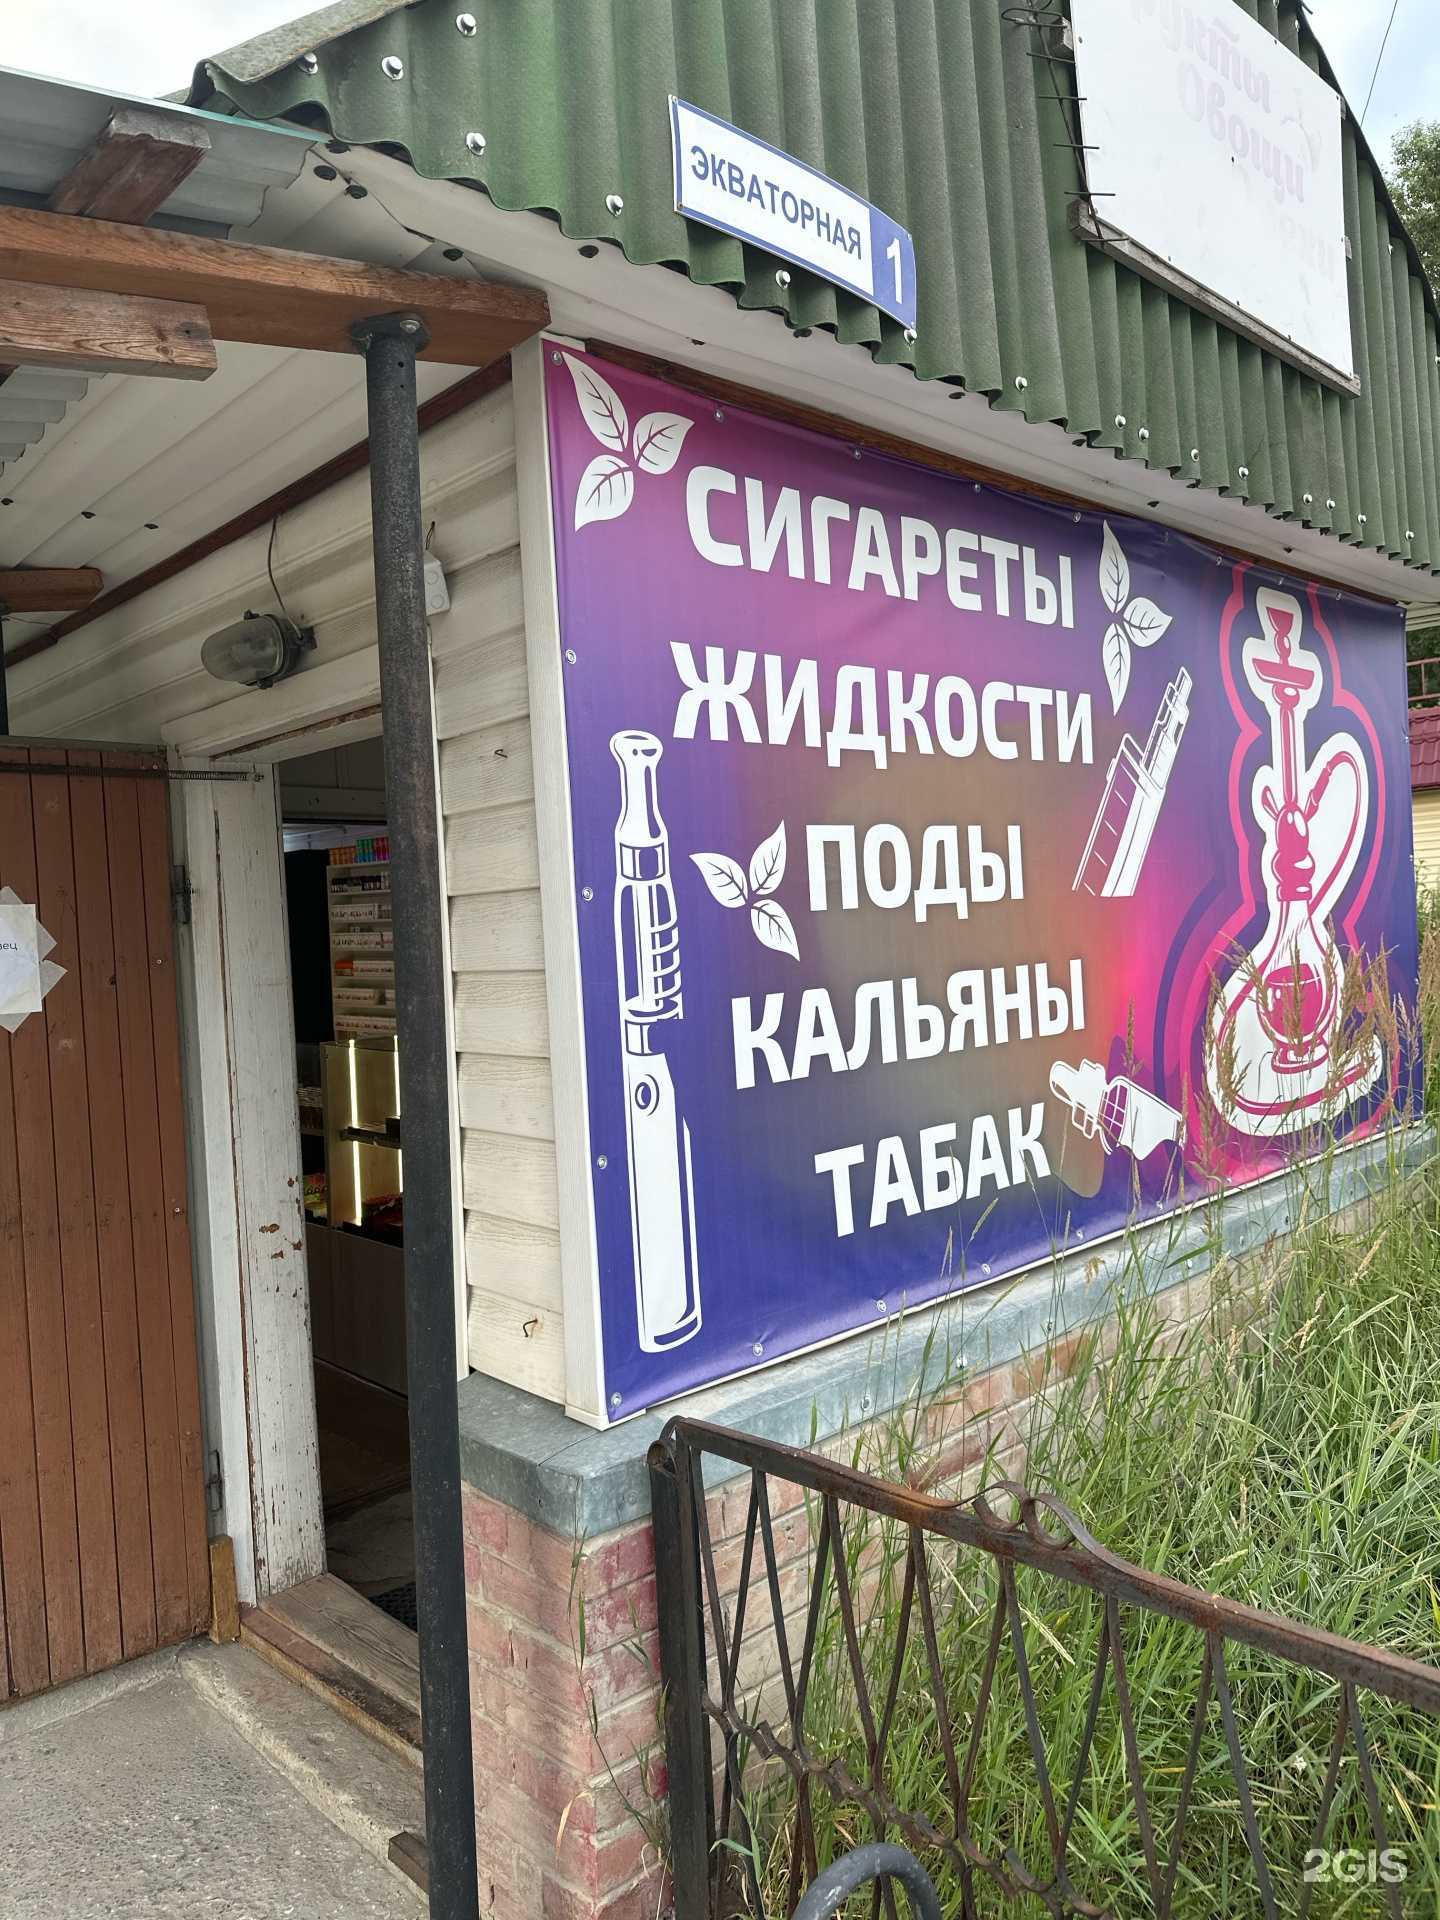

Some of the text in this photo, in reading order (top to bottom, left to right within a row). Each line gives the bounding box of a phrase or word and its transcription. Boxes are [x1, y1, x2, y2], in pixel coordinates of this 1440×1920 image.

[690, 145, 903, 304] ЭКВАТОРНАЯ 1
[686, 465, 1075, 629] СИГАРЕТЫ
[670, 640, 1094, 769] ЖИДКОСТИ
[805, 823, 1025, 923] ПОДЫ
[731, 959, 1085, 1090] КАЛЬЯНЫ
[814, 1102, 1051, 1238] ТАБАК
